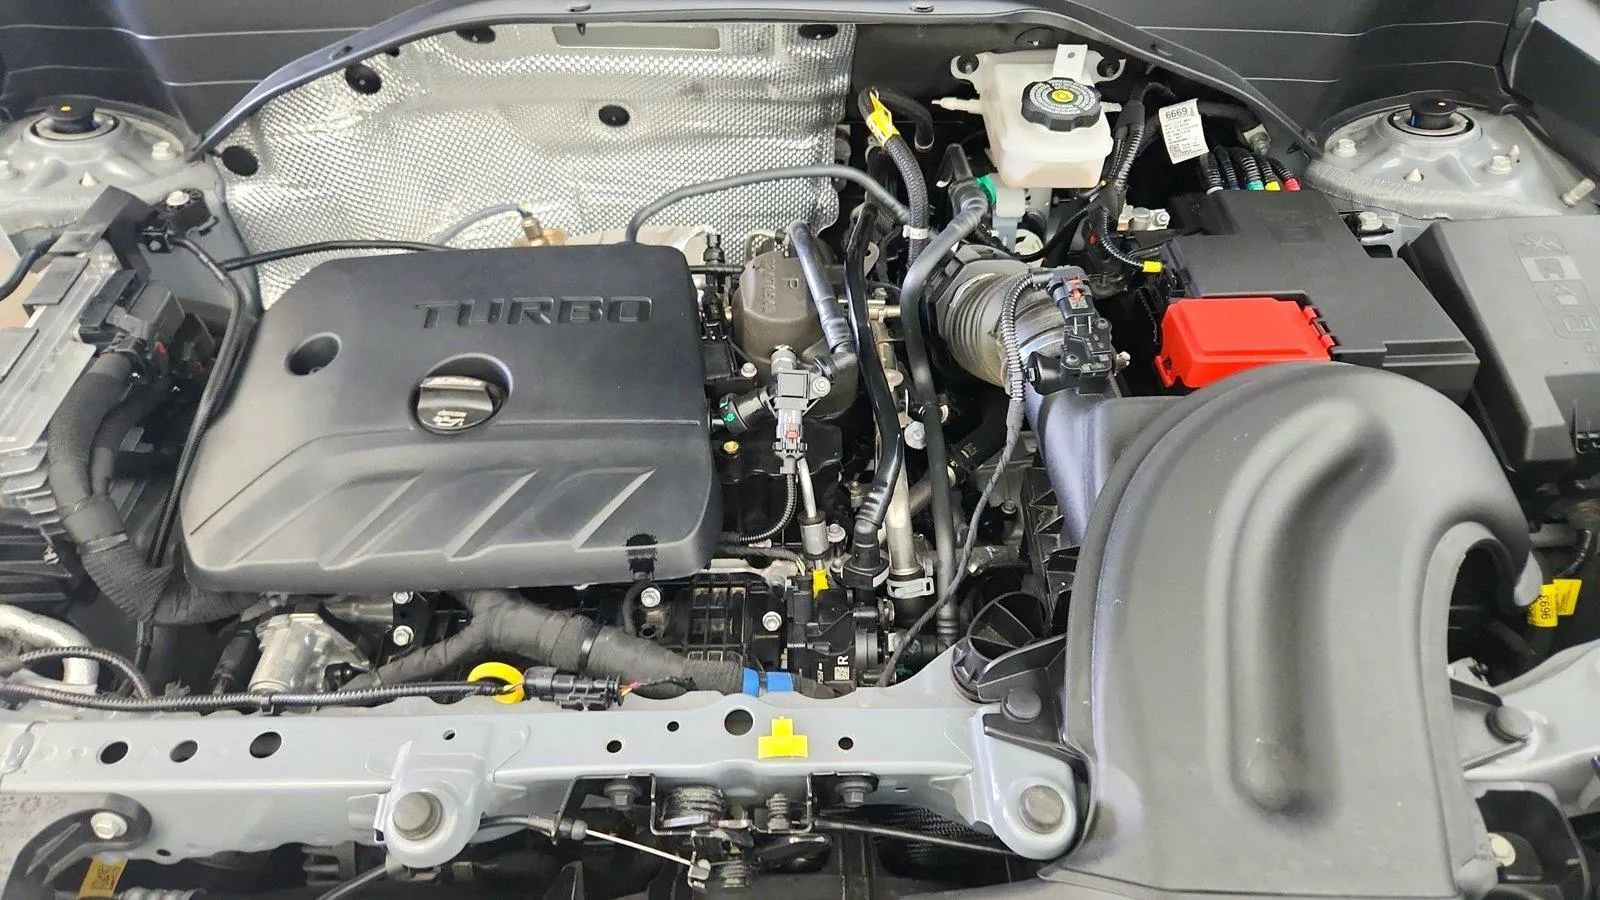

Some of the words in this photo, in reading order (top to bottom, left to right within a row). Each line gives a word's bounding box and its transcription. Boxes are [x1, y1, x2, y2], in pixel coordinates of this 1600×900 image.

[1165, 107, 1188, 119] 6669
[415, 295, 654, 329] TURBO
[1540, 594, 1551, 619] 9693
[837, 655, 849, 665] R
